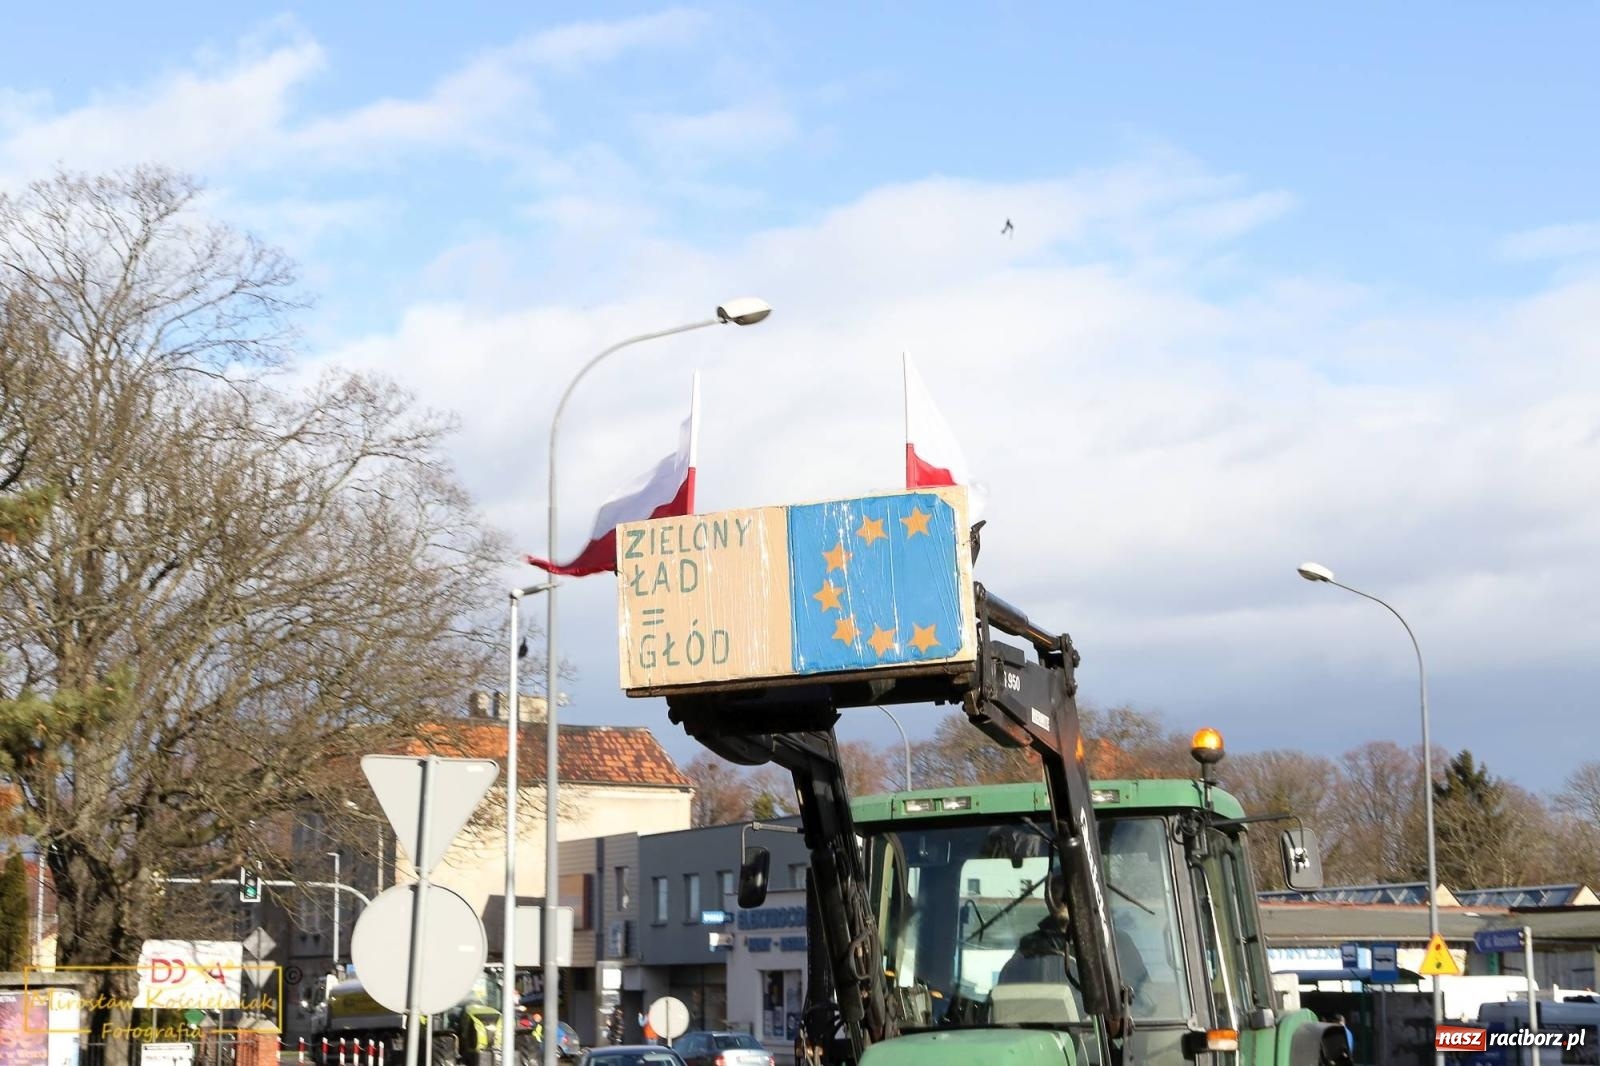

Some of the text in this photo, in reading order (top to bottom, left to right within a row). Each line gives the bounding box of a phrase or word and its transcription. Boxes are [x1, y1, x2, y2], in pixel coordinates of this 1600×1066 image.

[625, 518, 752, 559] ZIELONY
[630, 558, 698, 597] ŁAD
[639, 618, 730, 669] GŁÓD
